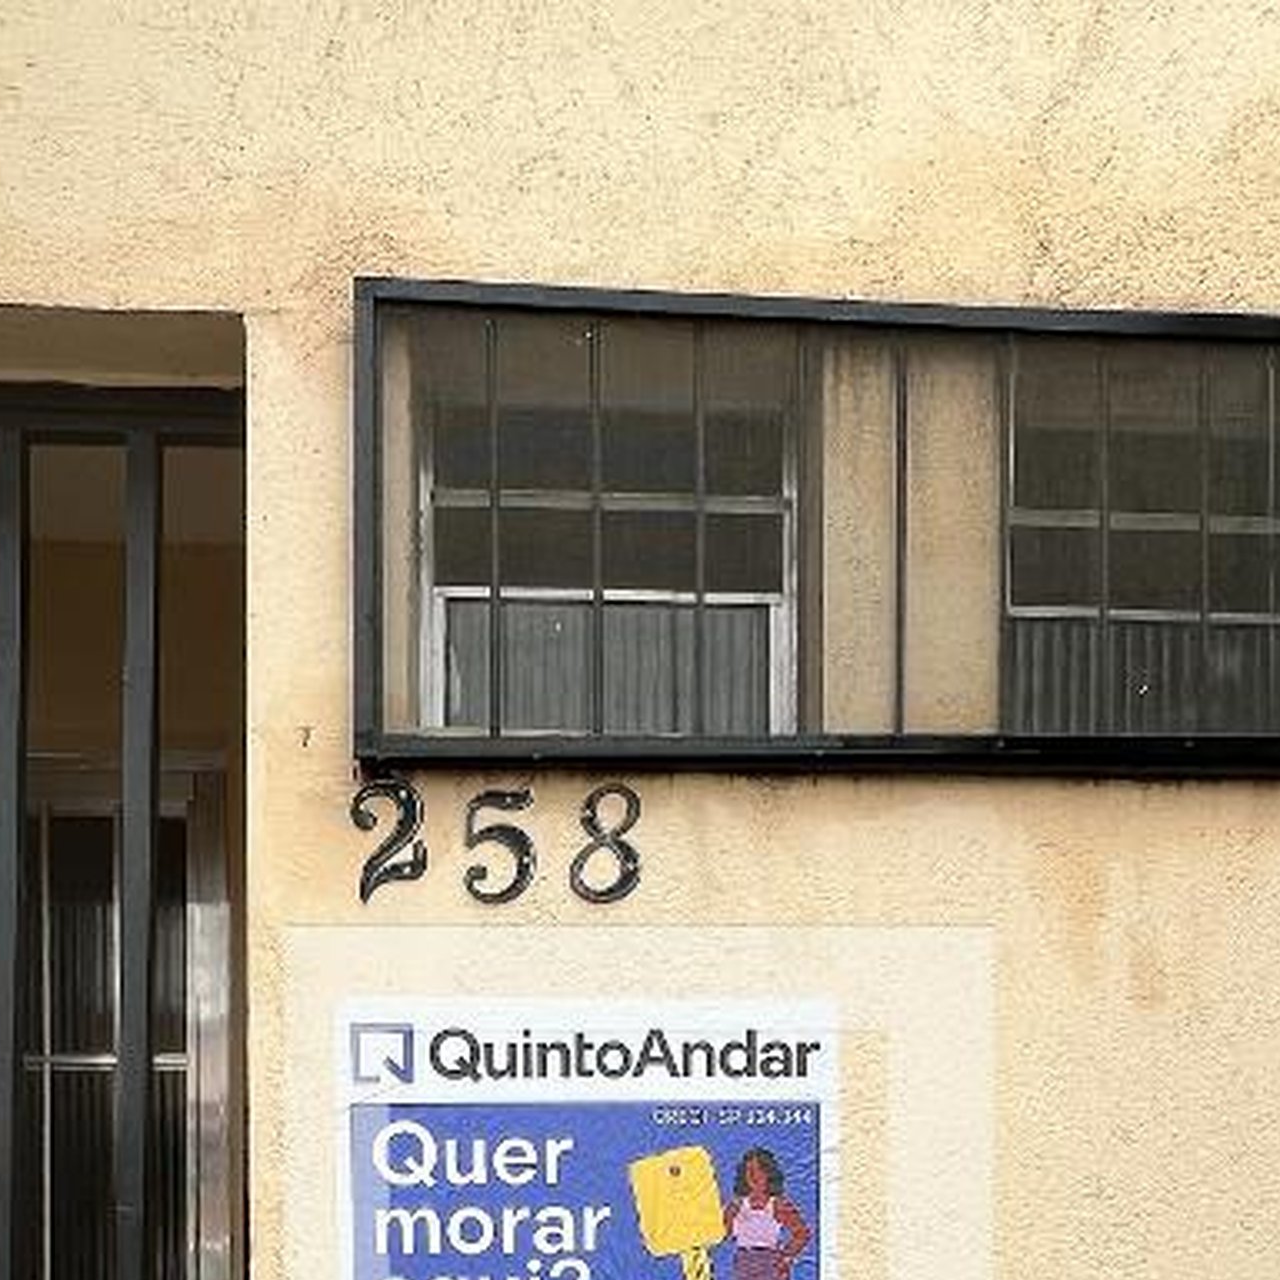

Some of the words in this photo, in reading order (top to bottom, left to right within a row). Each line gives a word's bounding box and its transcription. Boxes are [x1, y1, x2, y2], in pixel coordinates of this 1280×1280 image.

[350, 779, 644, 905] 258
[428, 1027, 822, 1083] QuintoAndar
[372, 1119, 574, 1190] Quer
[374, 1205, 612, 1255] morar
